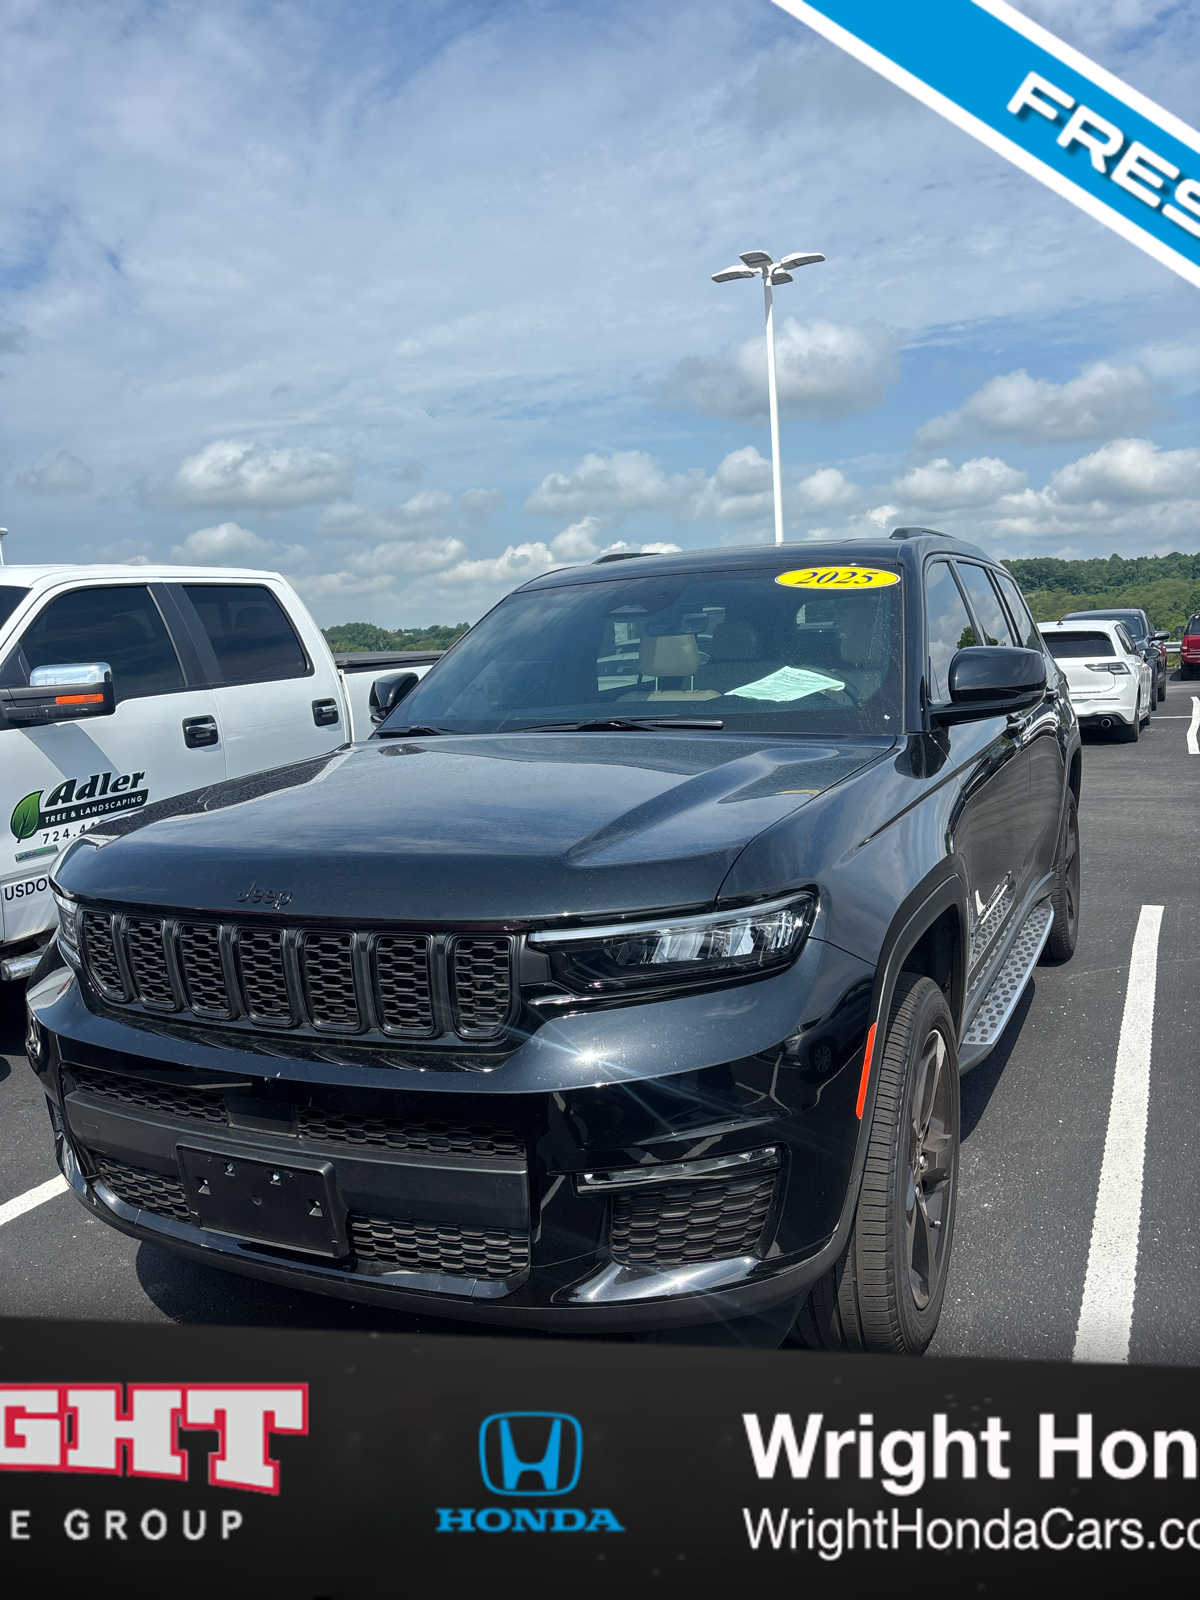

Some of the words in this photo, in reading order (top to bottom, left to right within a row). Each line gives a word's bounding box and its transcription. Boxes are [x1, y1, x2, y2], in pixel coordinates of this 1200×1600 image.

[796, 571, 878, 584] 2025
[45, 771, 145, 807] Adler
[45, 813, 67, 824] TREE
[80, 796, 143, 816] LANDSCAPING
[43, 822, 95, 844] 724.4
[237, 881, 293, 912] Jeep
